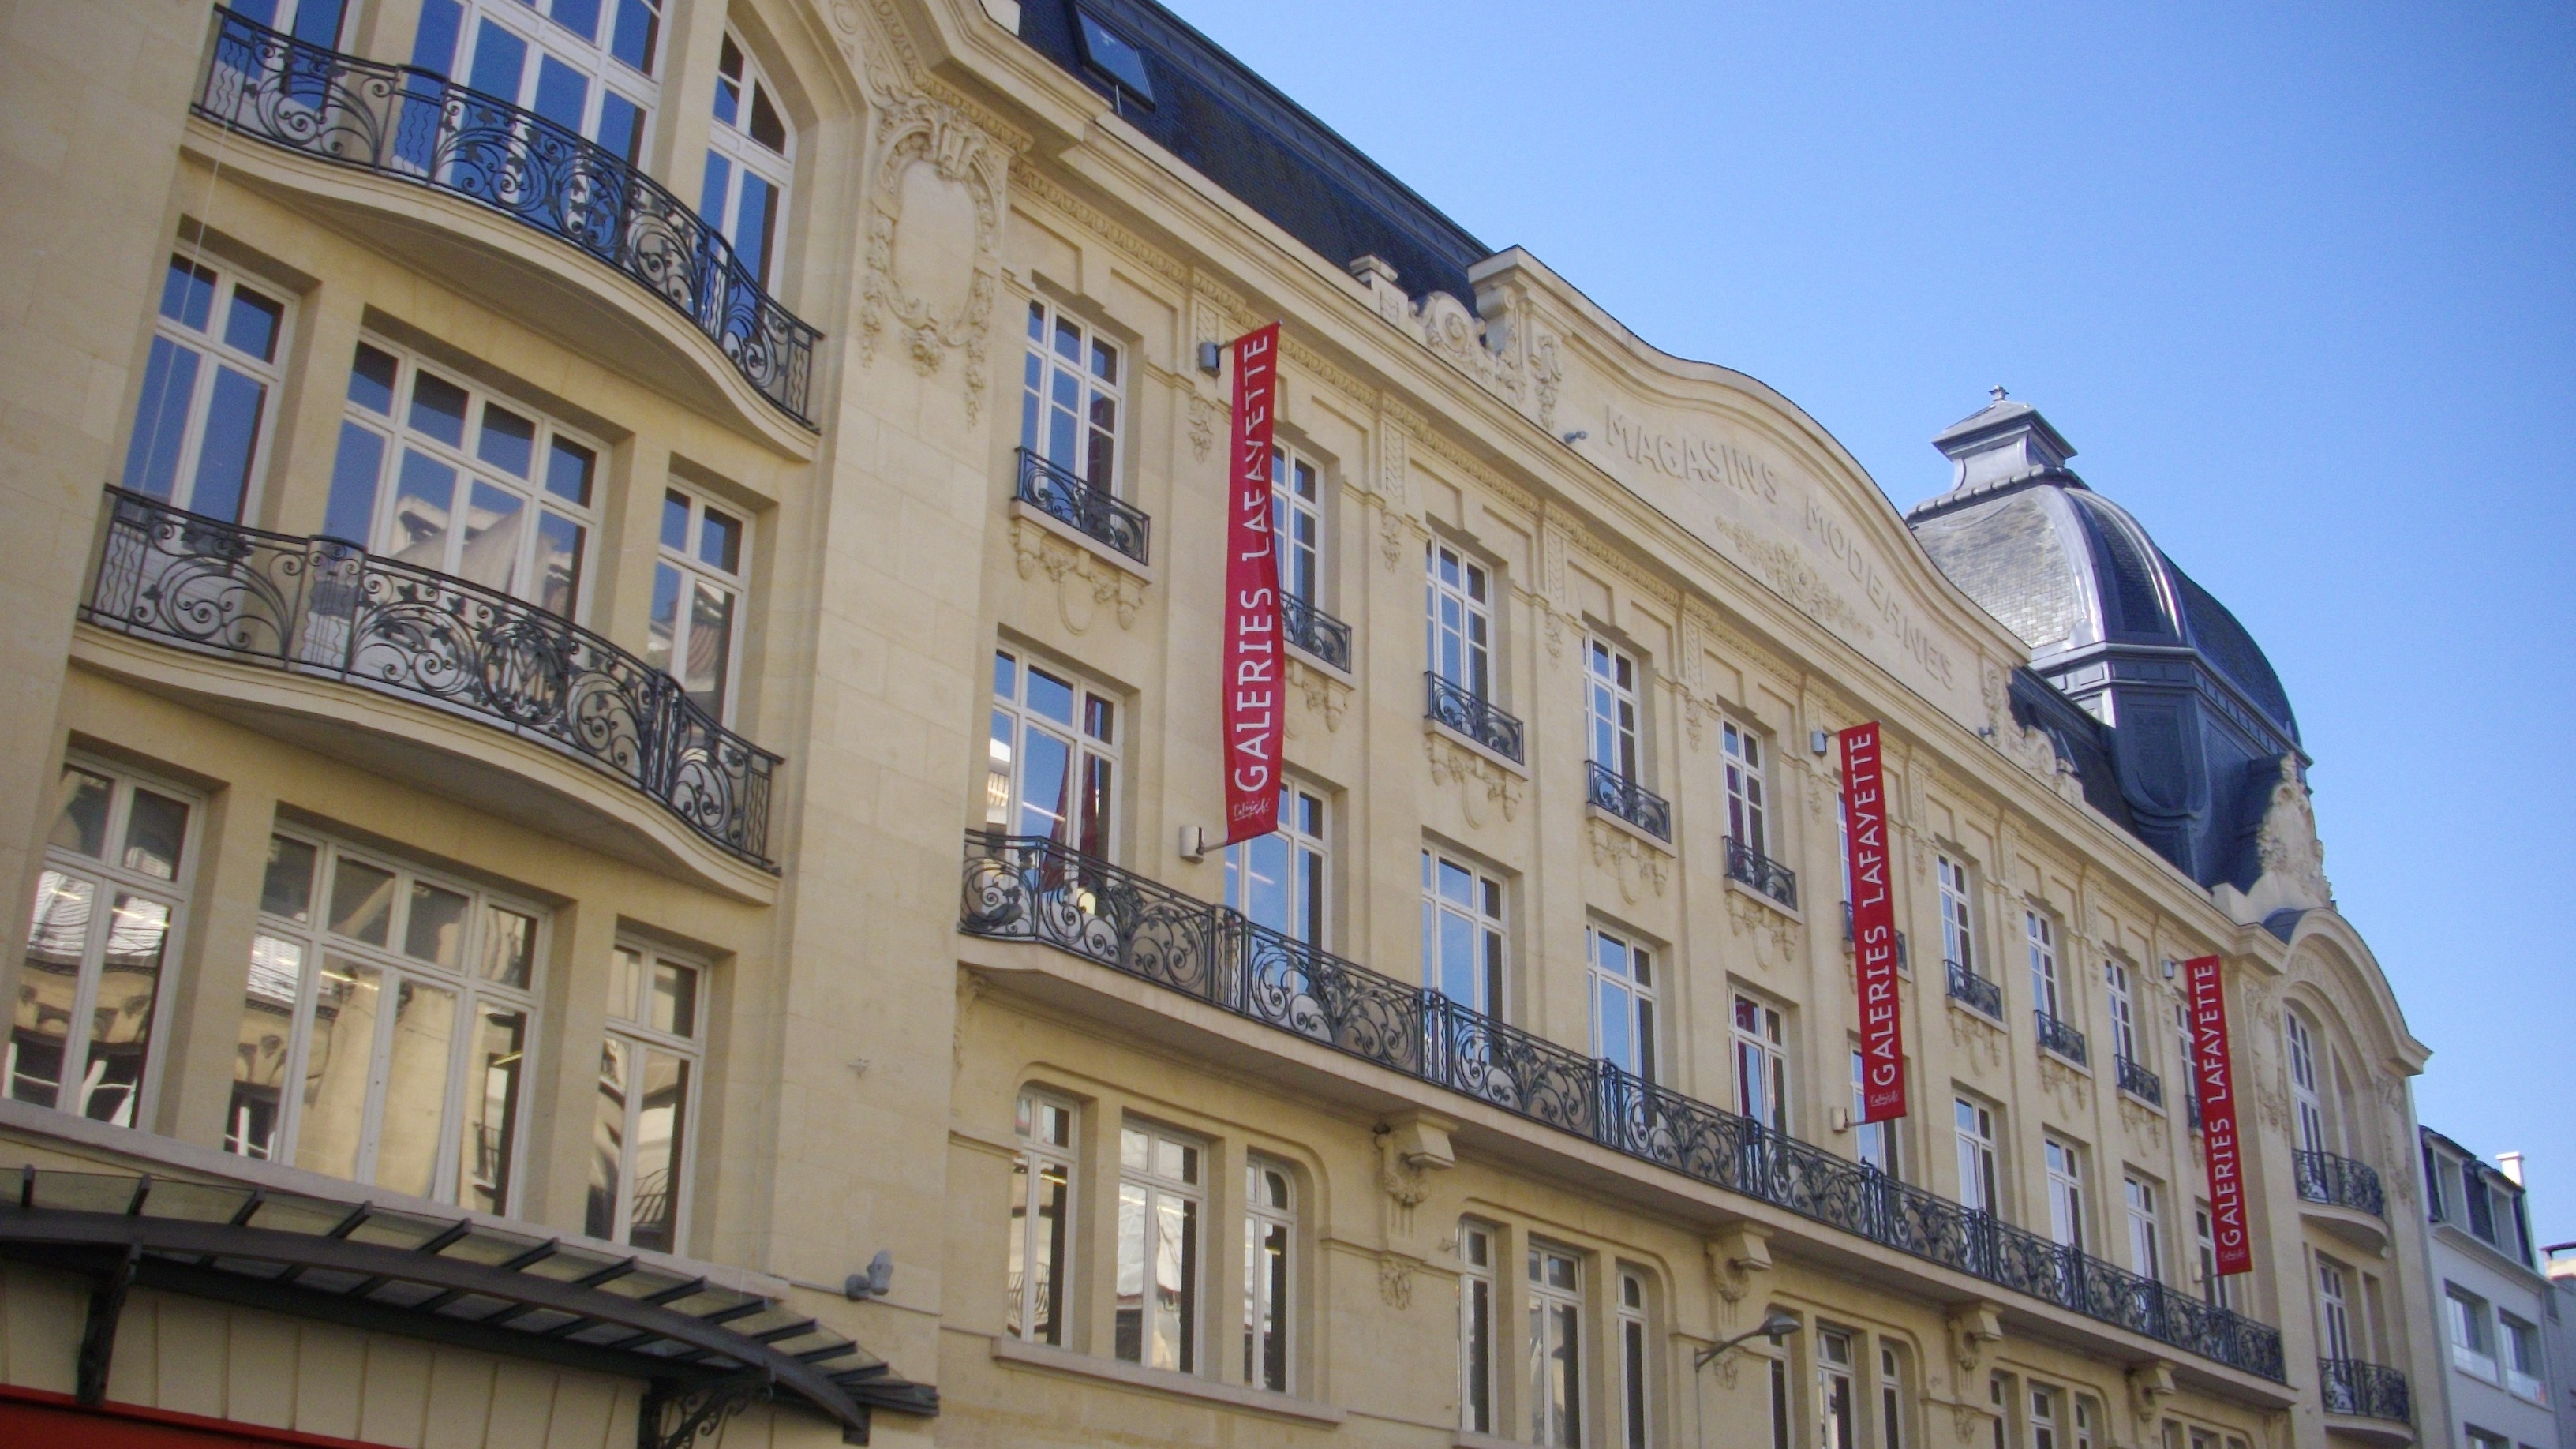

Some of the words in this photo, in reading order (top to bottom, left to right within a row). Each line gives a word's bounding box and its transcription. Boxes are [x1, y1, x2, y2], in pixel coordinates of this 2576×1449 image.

[1241, 335, 1270, 562] LAFAYETTE
[1605, 404, 1778, 504] MAGASINS
[1805, 493, 1954, 691] MODERNES
[1234, 588, 1272, 792] GALERIES
[1849, 732, 1885, 908] LAFAYETTE
[1864, 924, 1896, 1087] GALERIES
[2193, 964, 2226, 1103] LAFAYETTE
[2210, 1118, 2241, 1247] GALERIES
